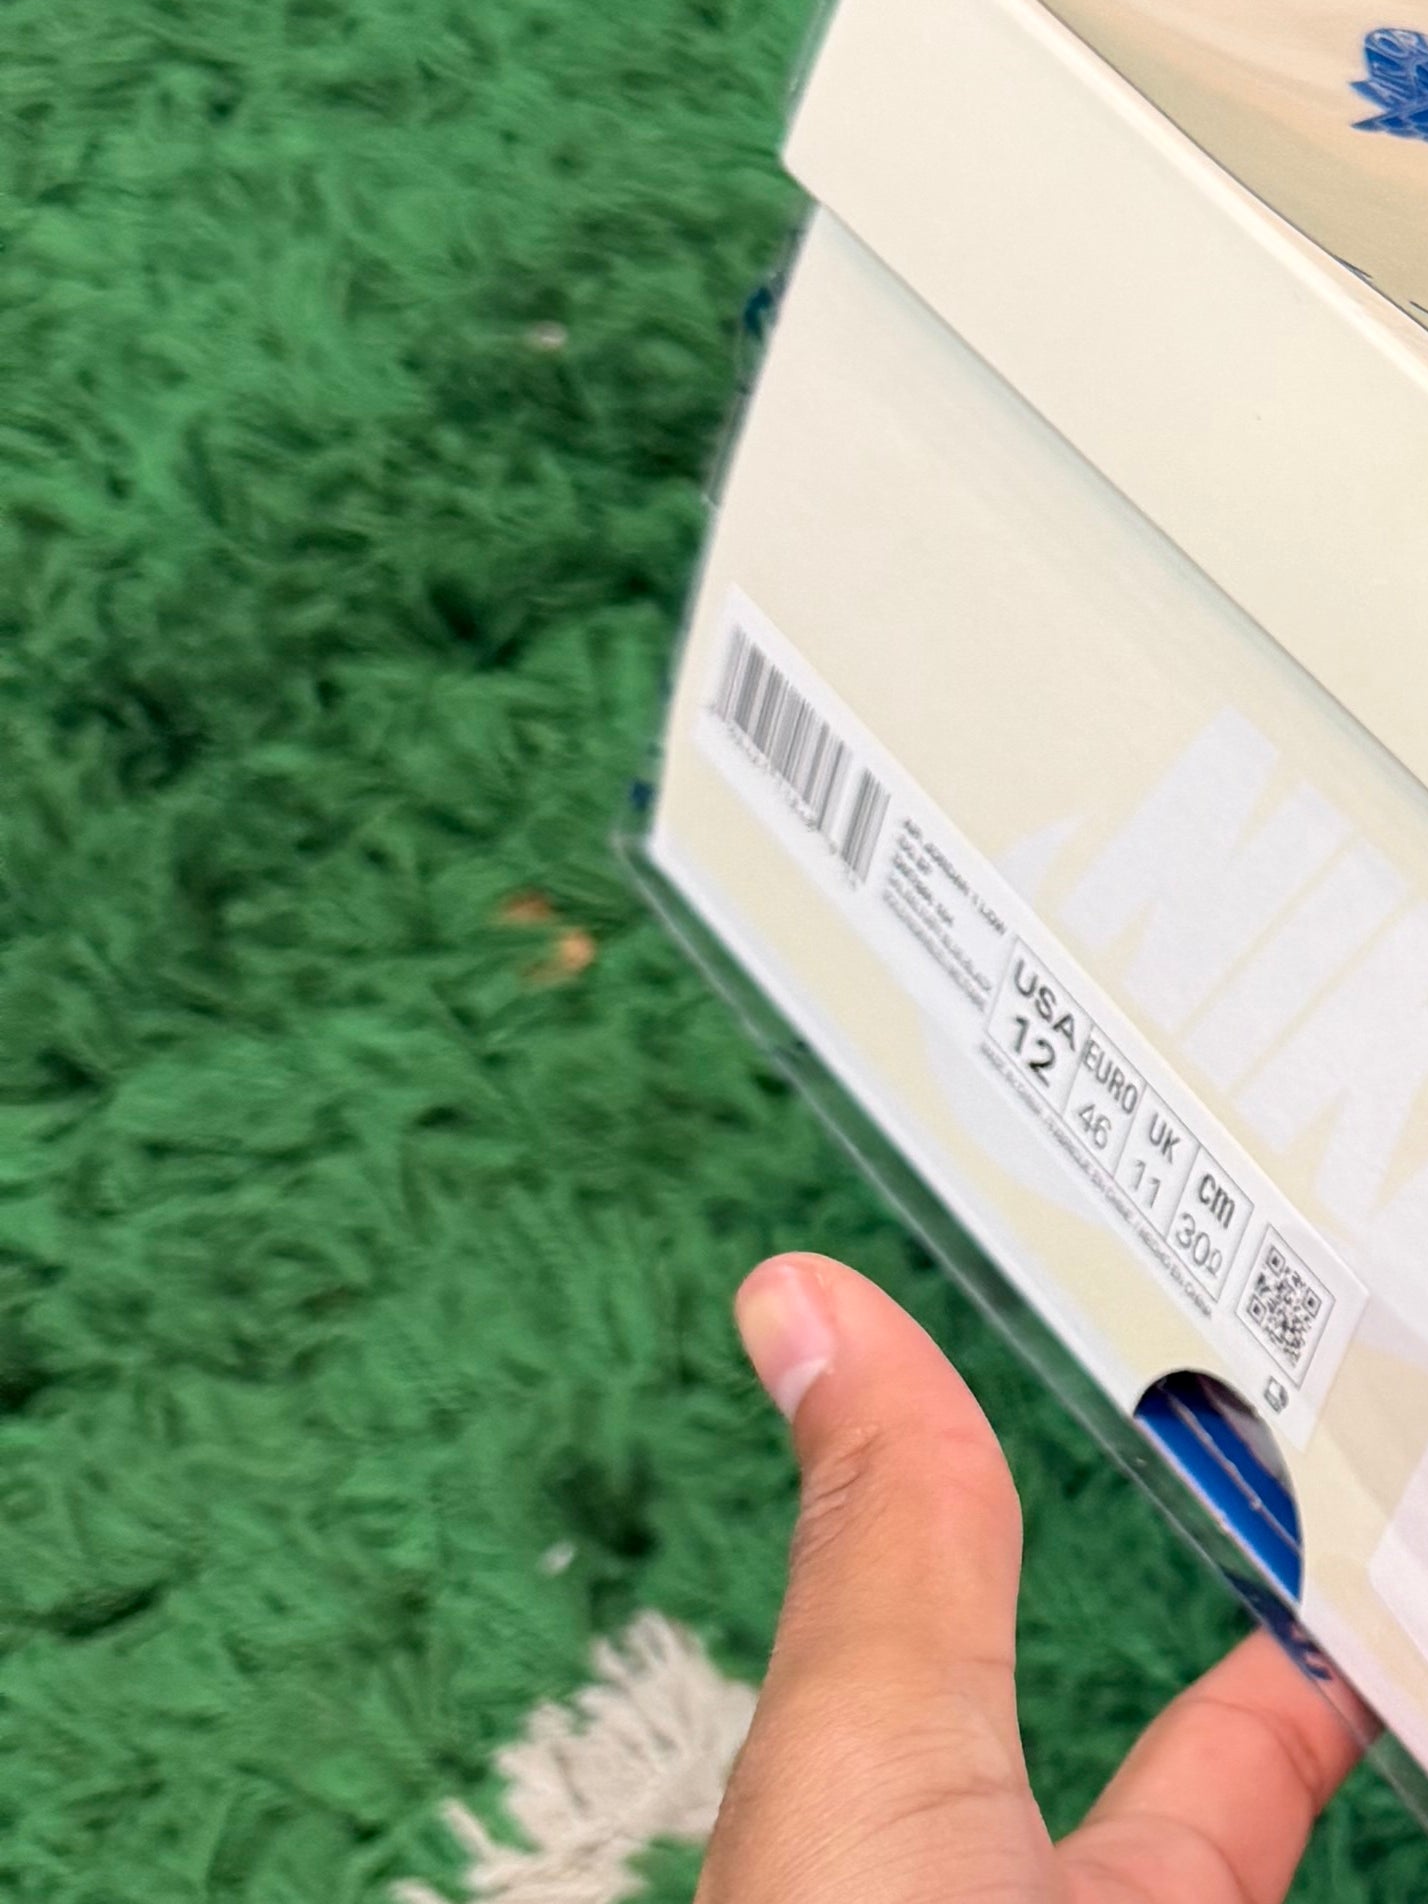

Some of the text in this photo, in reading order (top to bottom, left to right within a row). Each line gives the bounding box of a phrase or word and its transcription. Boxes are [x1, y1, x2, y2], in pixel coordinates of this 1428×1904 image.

[1013, 959, 1236, 1230] USA EURO UK cm
[1014, 1015, 1057, 1089] 12
[1078, 1103, 1112, 1150] 46
[1132, 1159, 1162, 1209] 11
